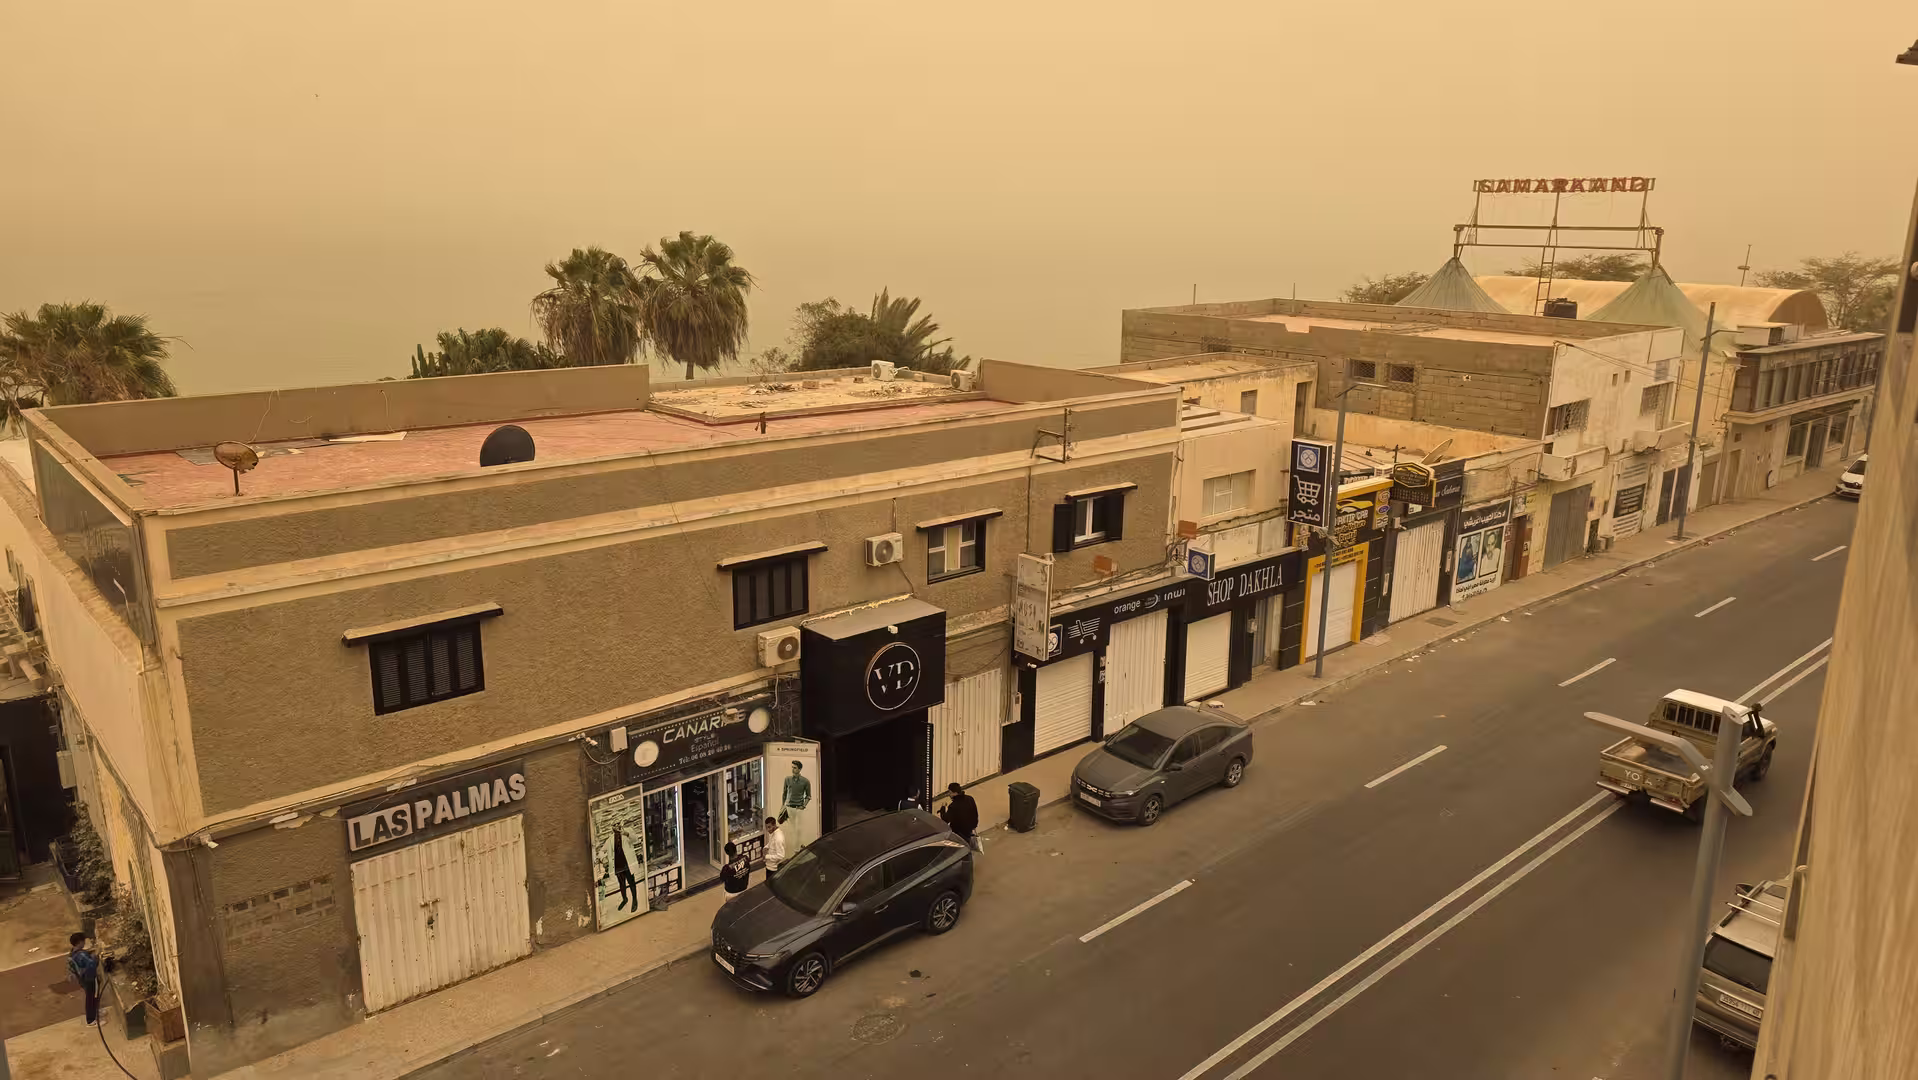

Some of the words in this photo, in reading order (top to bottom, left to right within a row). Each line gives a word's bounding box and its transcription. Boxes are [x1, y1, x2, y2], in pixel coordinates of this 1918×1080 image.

[1478, 176, 1649, 194] SAMARKAND
[1290, 508, 1321, 522] متجر
[1207, 580, 1234, 607] SHOP
[1239, 563, 1283, 598] DAKHLA
[1114, 600, 1141, 614] orange
[353, 807, 410, 848] LAS
[415, 774, 526, 829] PALMAS
